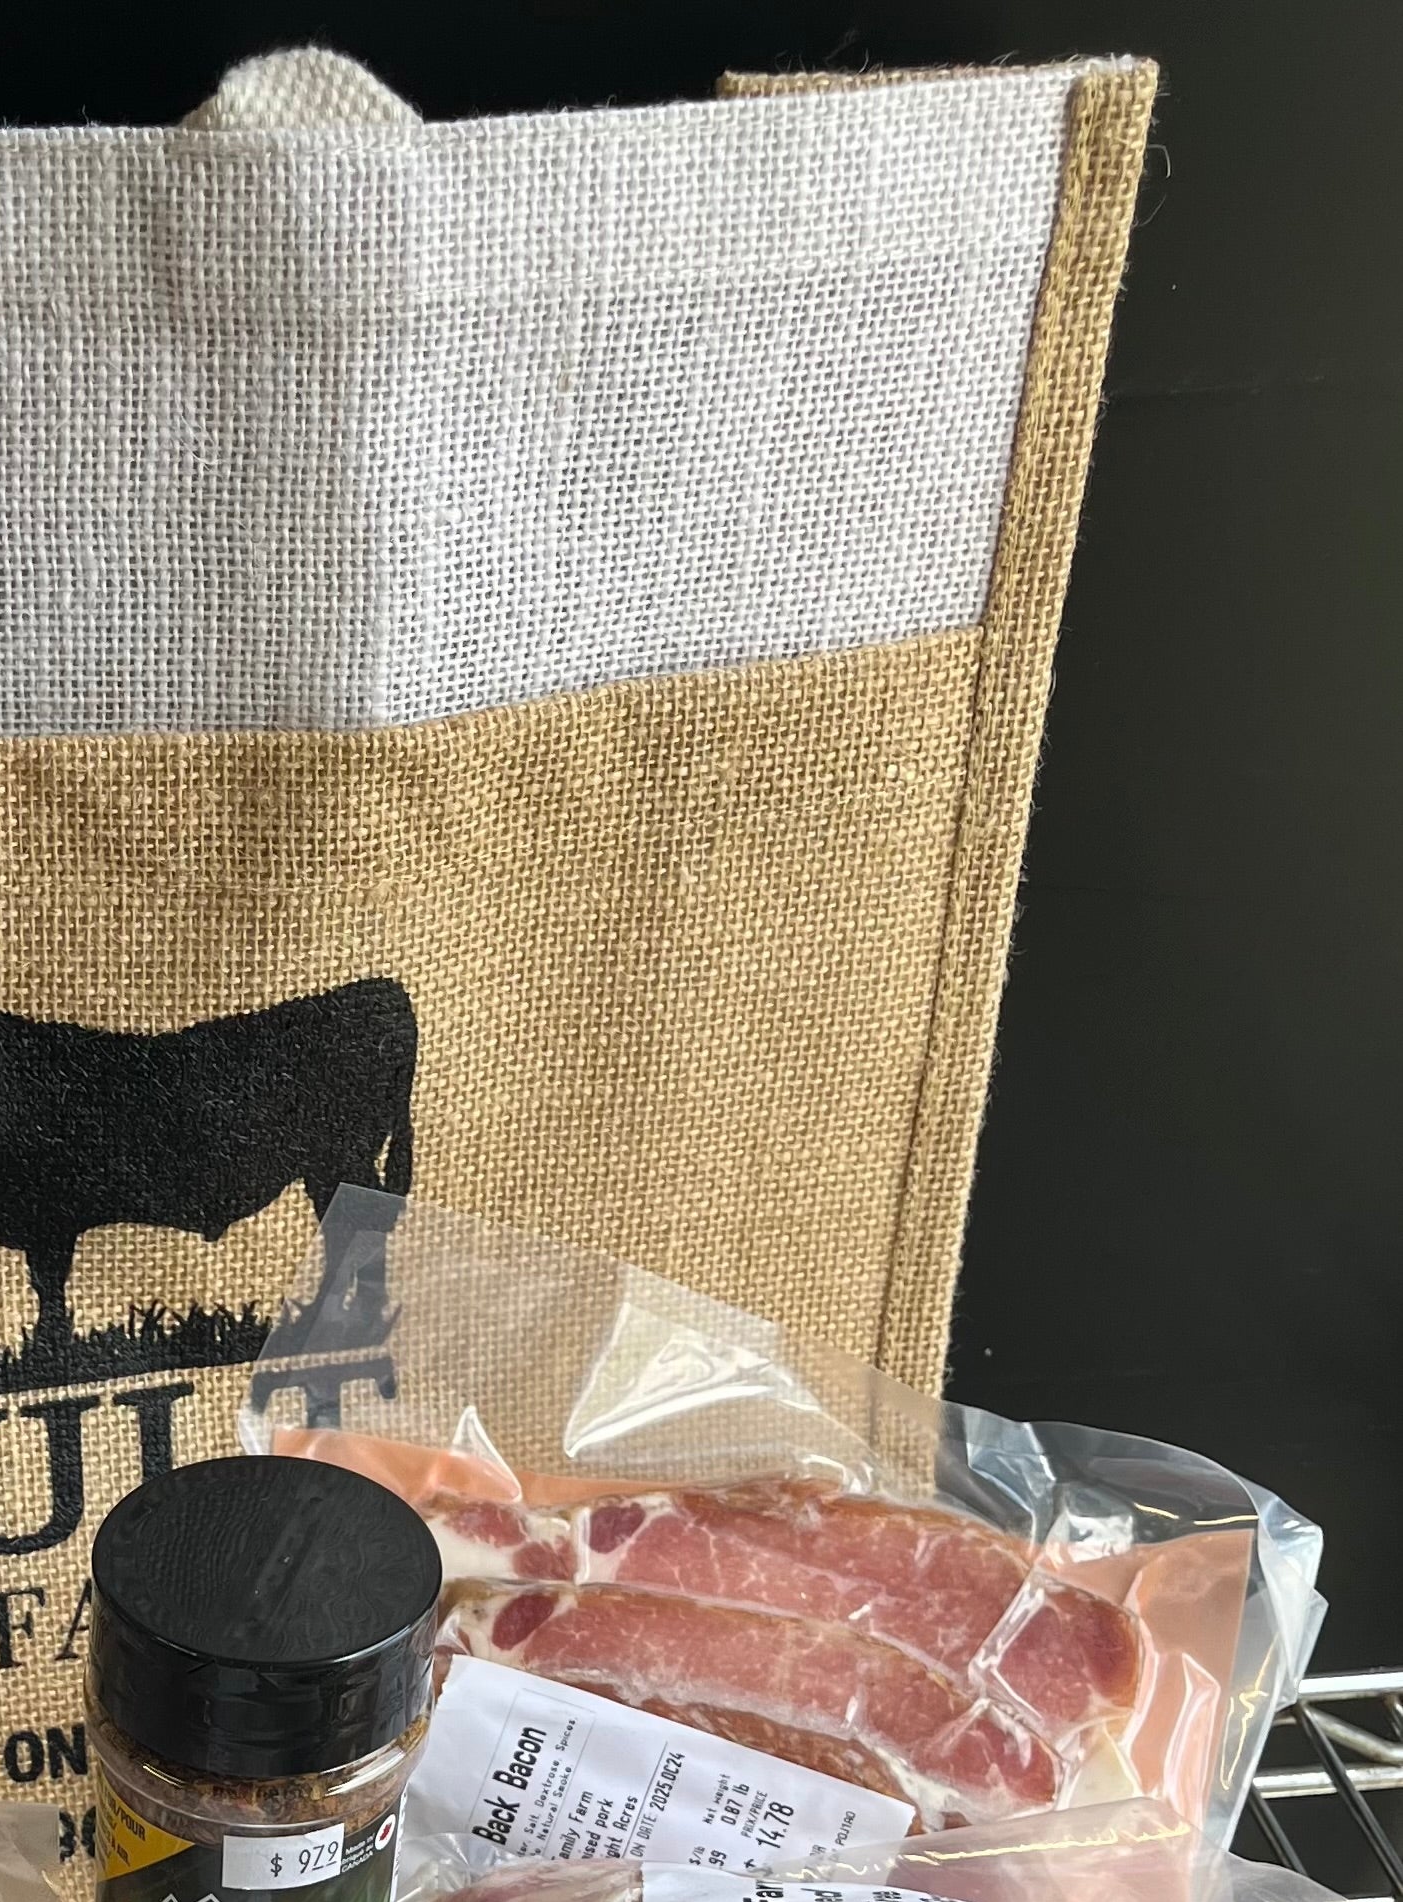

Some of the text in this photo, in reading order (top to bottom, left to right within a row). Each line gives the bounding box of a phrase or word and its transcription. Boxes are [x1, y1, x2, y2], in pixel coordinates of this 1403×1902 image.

[4, 1722, 88, 1783] ON
[471, 1727, 547, 1845] Back Bacon
[720, 1784, 750, 1825] 0.87 lb
[536, 1802, 558, 1840] Natural
[551, 1791, 593, 1861] amily Farm
[594, 1798, 613, 1829] pork
[612, 1796, 638, 1831] Acres
[740, 1790, 768, 1838] PRIX/PRICE
[755, 1801, 794, 1849] 14.78
[341, 1850, 374, 1873] CANADA
